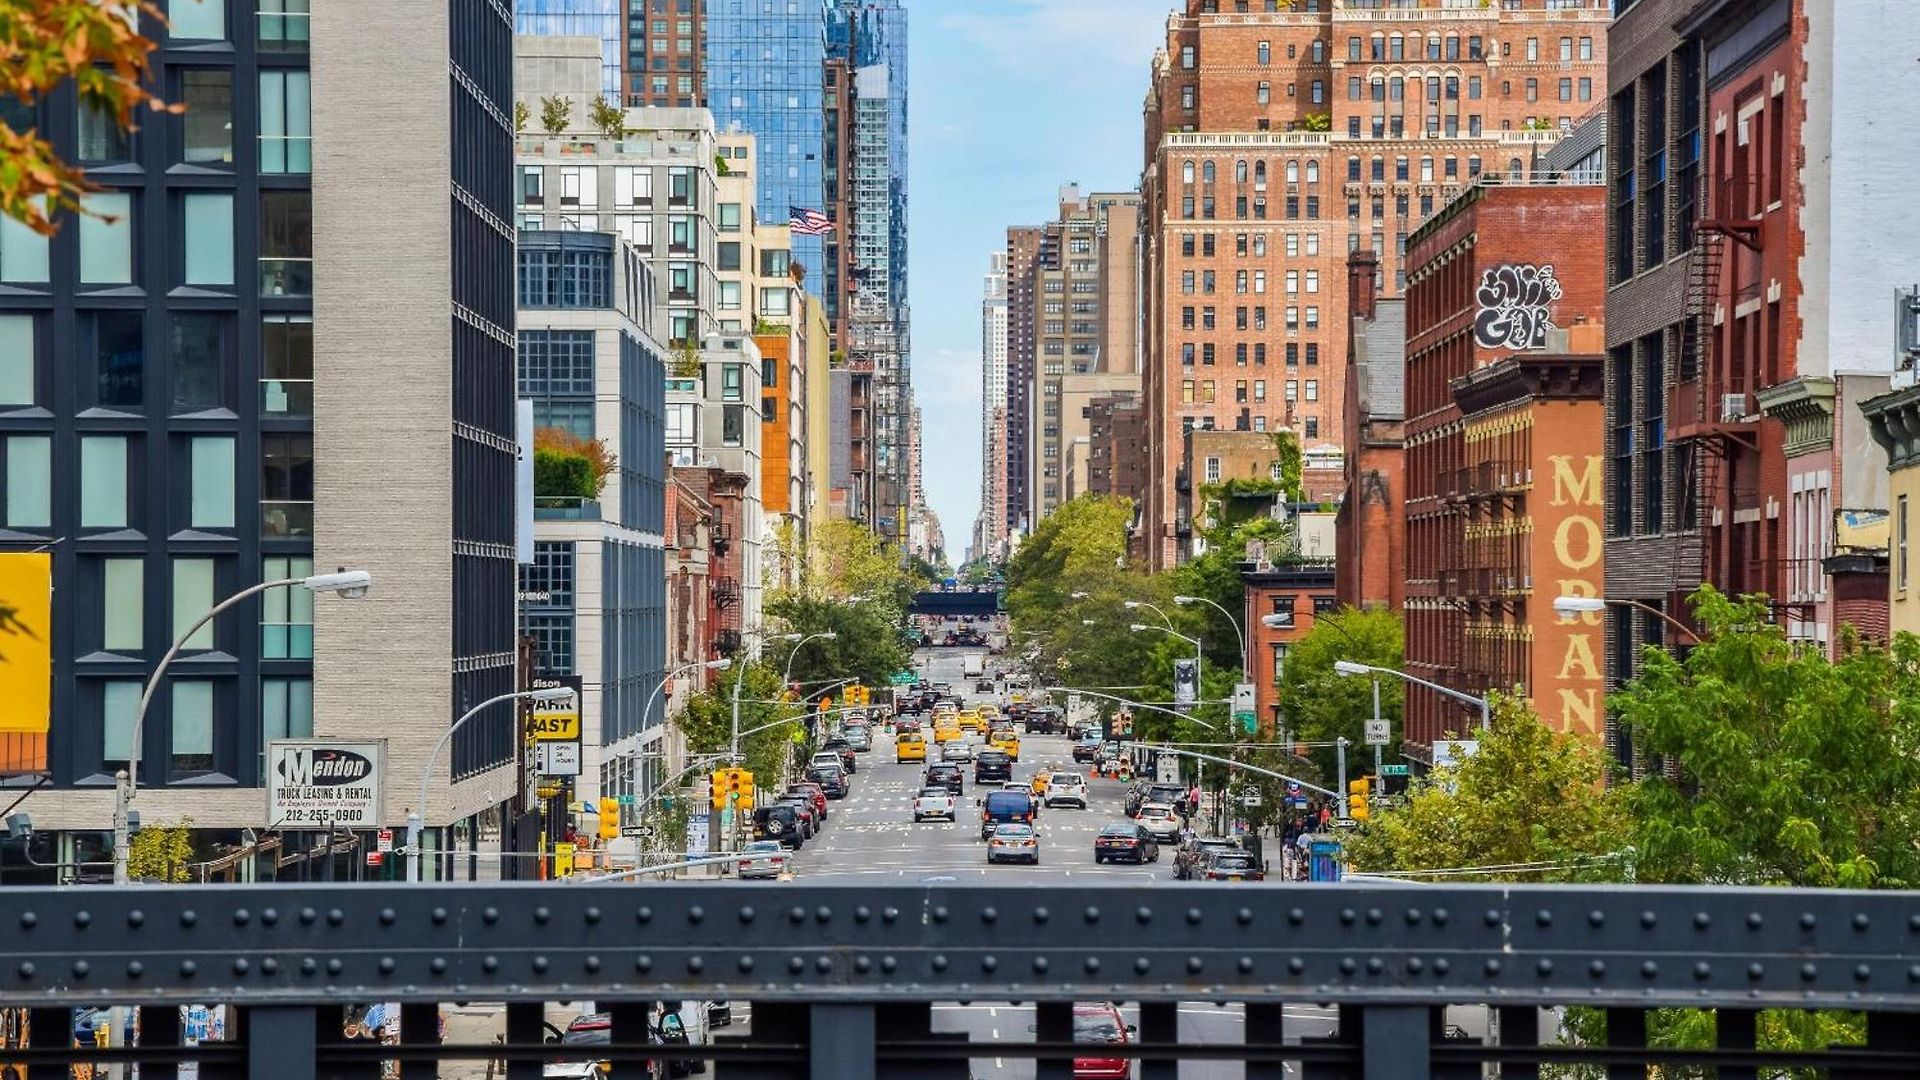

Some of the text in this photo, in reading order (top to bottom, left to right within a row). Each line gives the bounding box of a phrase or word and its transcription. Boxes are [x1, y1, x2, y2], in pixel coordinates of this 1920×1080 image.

[1547, 454, 1604, 734] MORAN
[1372, 723, 1383, 732] NO
[1367, 733, 1388, 741] TURNS
[284, 748, 365, 787] Mendon
[278, 787, 372, 800] TRUCK LEASING & RENTAL
[286, 809, 363, 821] 212-255-0900
